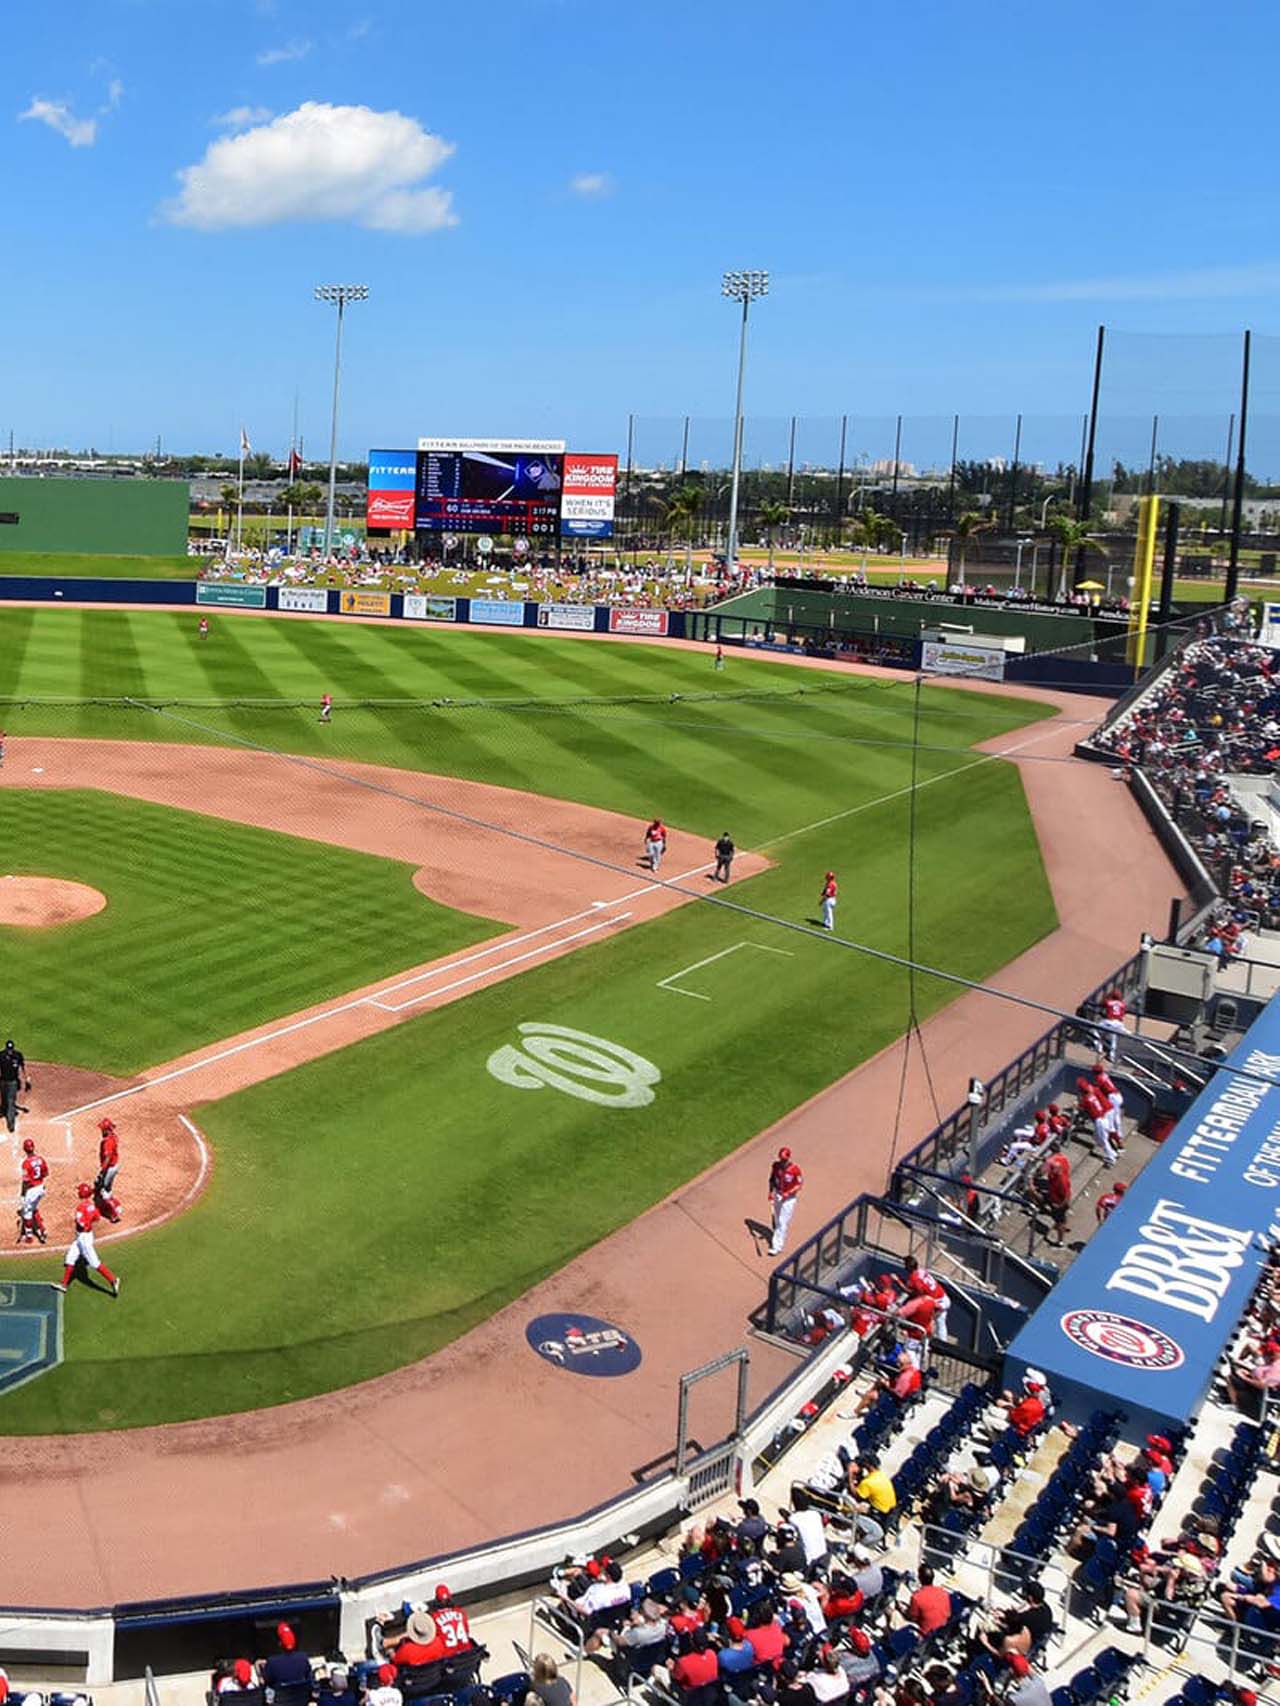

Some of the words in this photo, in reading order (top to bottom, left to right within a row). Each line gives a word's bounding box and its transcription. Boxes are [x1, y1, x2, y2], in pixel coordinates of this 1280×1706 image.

[370, 466, 416, 475] FITTEAM
[566, 507, 607, 516] SERIOUS
[849, 584, 890, 597] Anderson
[924, 591, 957, 603] Center
[639, 612, 661, 621] TIRE
[1106, 1200, 1254, 1323] BB&T
[441, 1621, 469, 1648] 34
